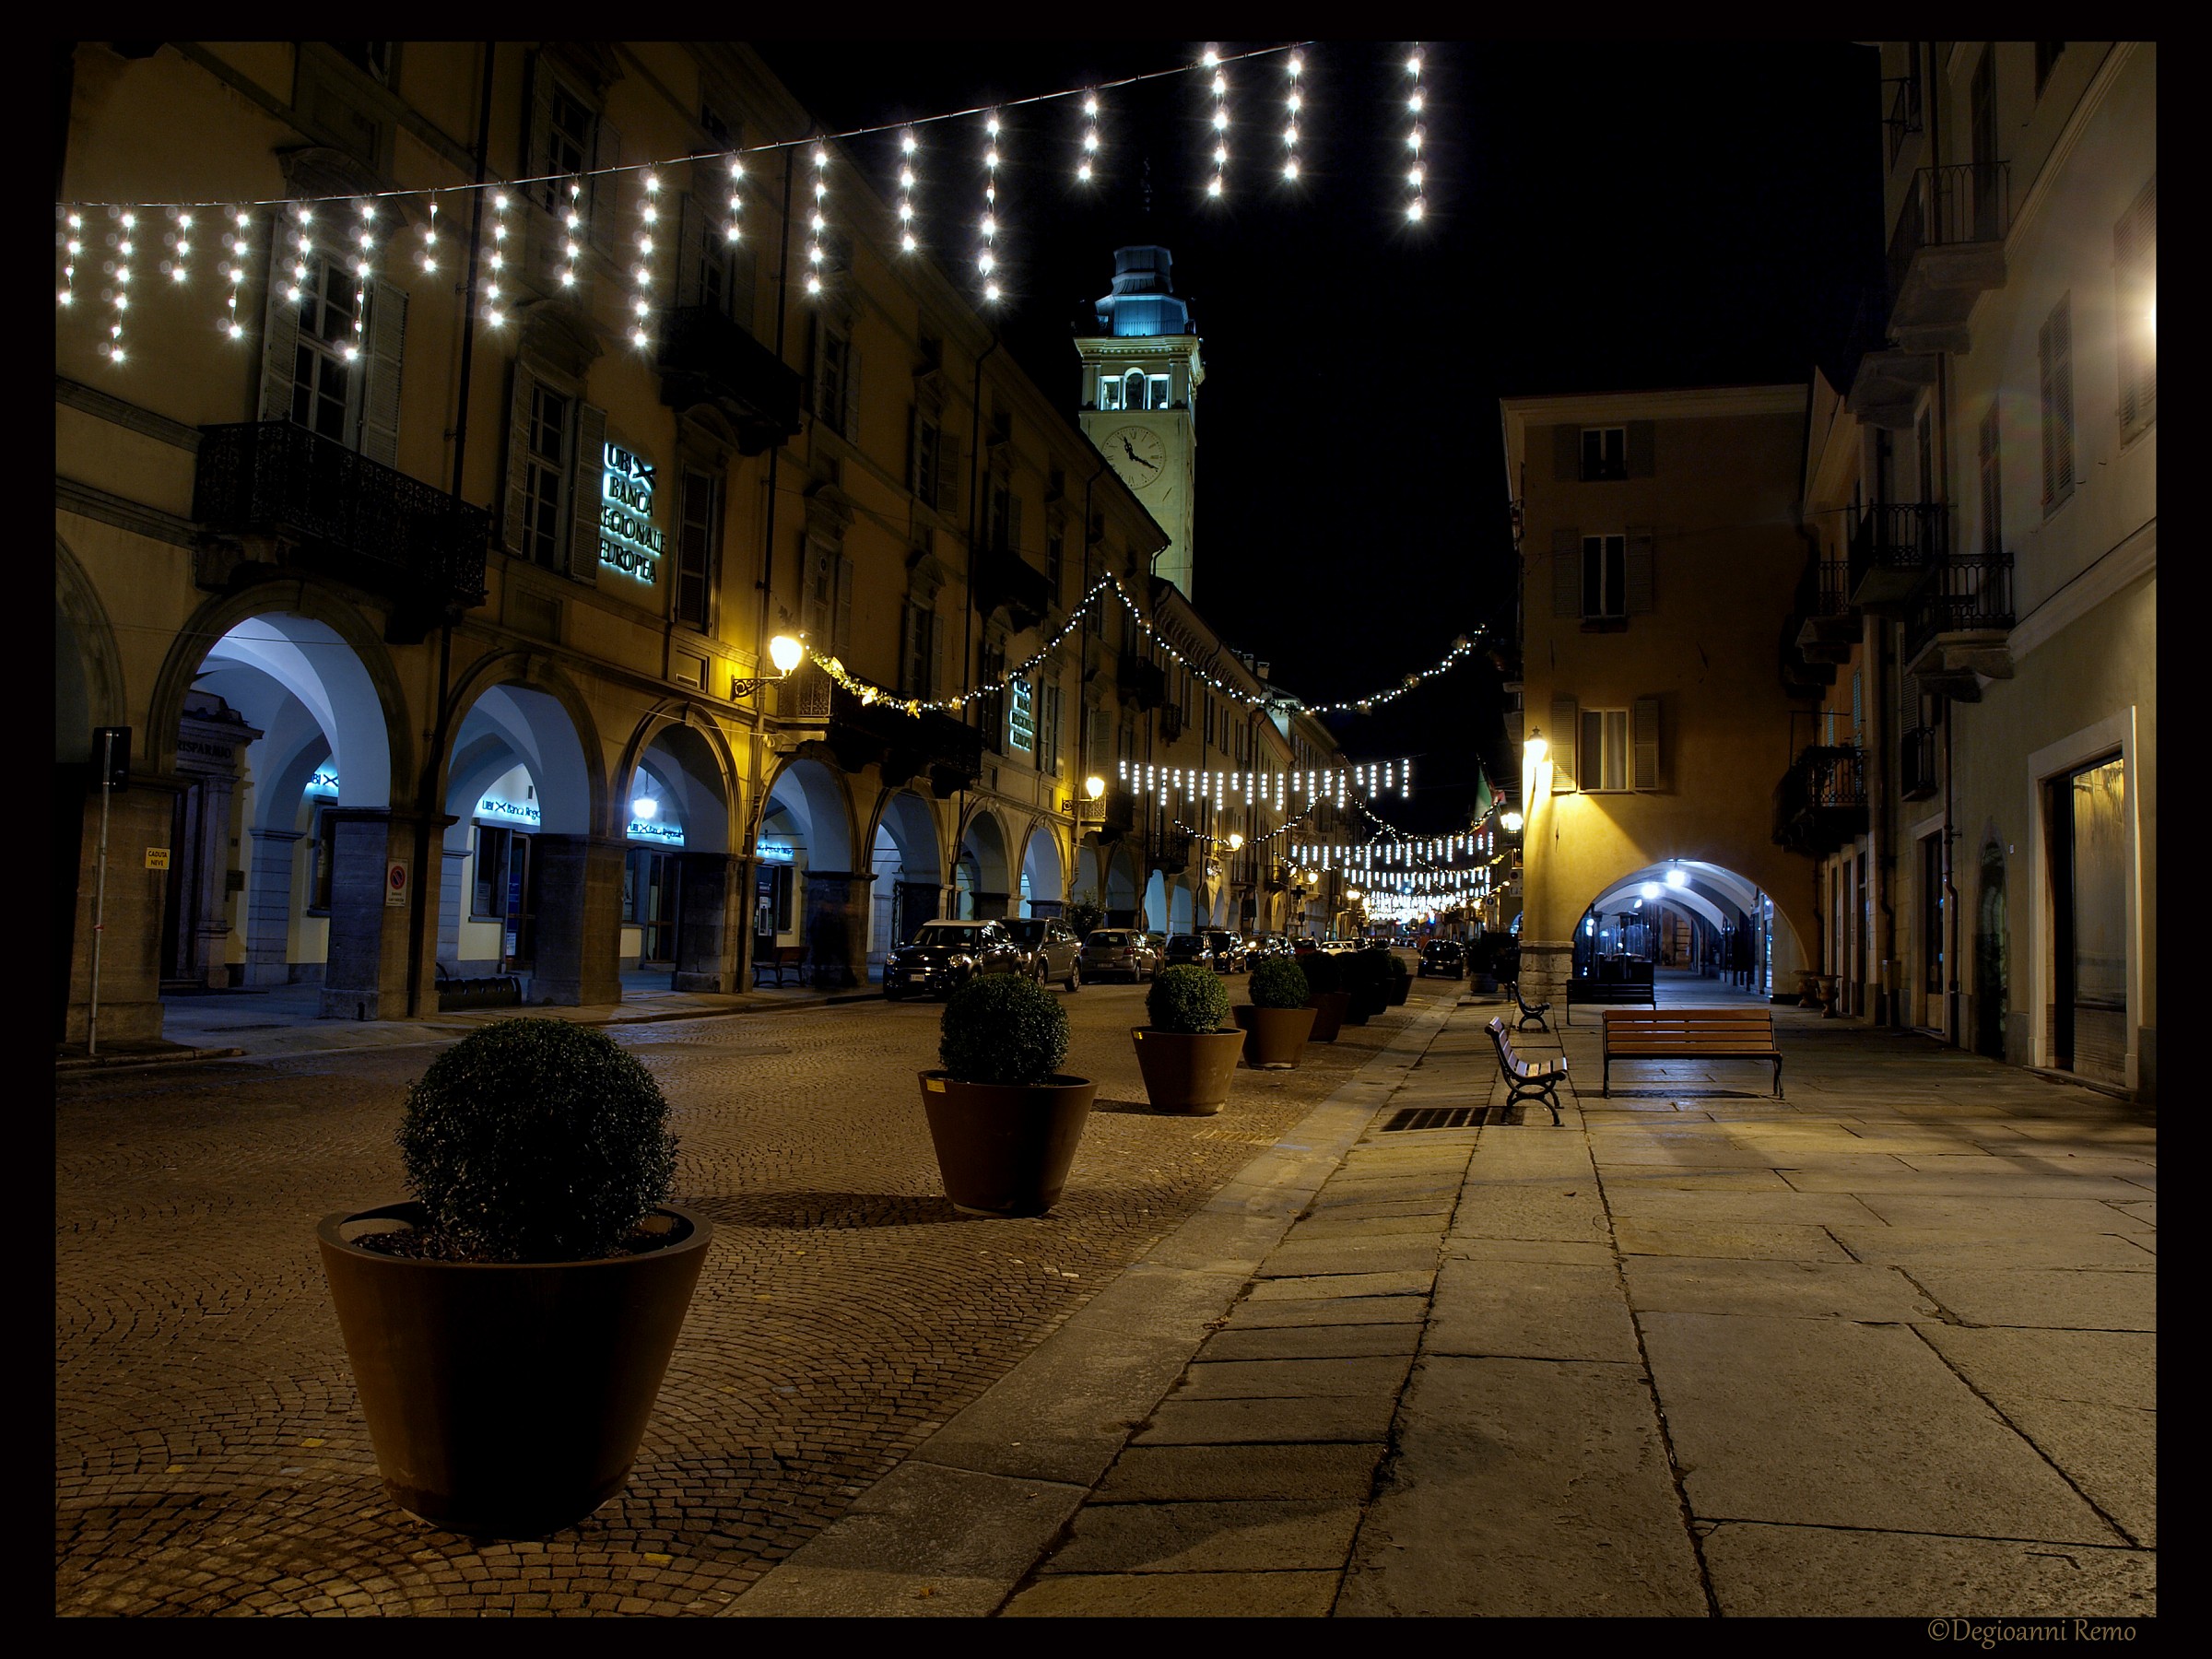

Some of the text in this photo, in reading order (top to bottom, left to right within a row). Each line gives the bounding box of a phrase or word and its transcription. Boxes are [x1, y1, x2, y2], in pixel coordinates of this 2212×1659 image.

[606, 443, 634, 477] UBI
[608, 476, 653, 517] BANCA
[599, 537, 657, 583] EUROPEA
[147, 850, 168, 858] CADUTA
